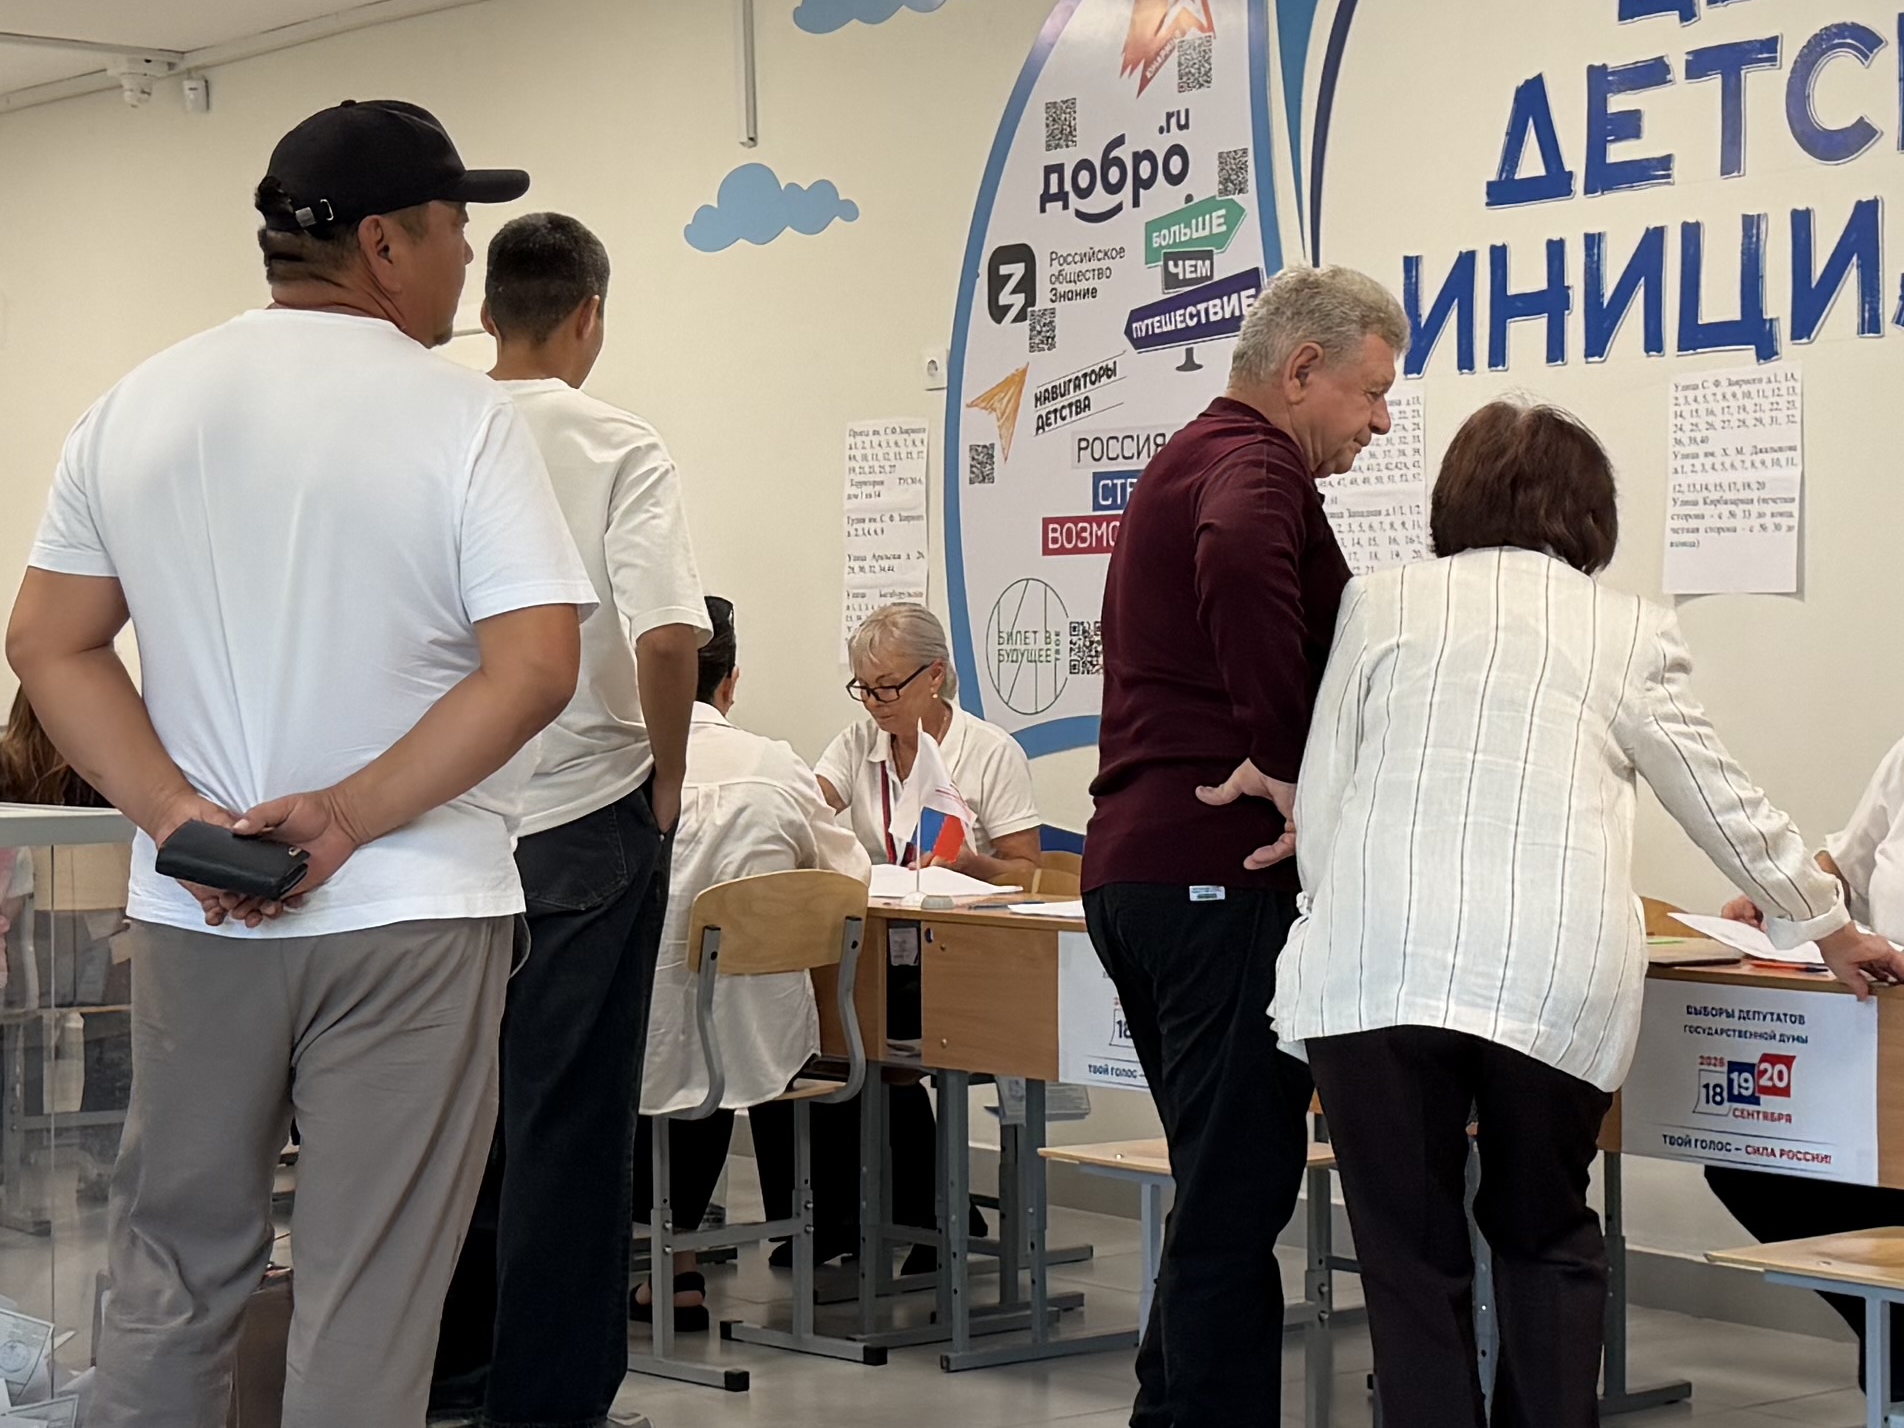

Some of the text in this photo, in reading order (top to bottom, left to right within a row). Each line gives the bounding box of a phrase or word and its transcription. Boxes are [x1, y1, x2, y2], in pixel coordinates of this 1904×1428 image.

[1158, 108, 1190, 135] .ru
[1039, 133, 1189, 213] добро
[1152, 209, 1227, 249] БОЛЬШЕ
[1049, 246, 1125, 267] Российское
[1049, 267, 1112, 285] общество
[1167, 259, 1211, 280] ЧЕМ
[1049, 286, 1098, 303] Знание
[1132, 288, 1256, 338] ПУТЕШЕСТВИЕ
[1034, 361, 1117, 408] НАВИГАТОРЫ
[1035, 395, 1091, 436] ДЕТСТВА
[997, 630, 1052, 646] БИЛЕТ В
[997, 648, 1052, 663] БУДУЩЕЕ
[1736, 1008, 1806, 1025] ДЕПУТАТОВ
[1702, 1063, 1789, 1106] 18 19 20
[1661, 1133, 1692, 1148] ТВОЙ
[1693, 1137, 1732, 1153] ГОЛОС
